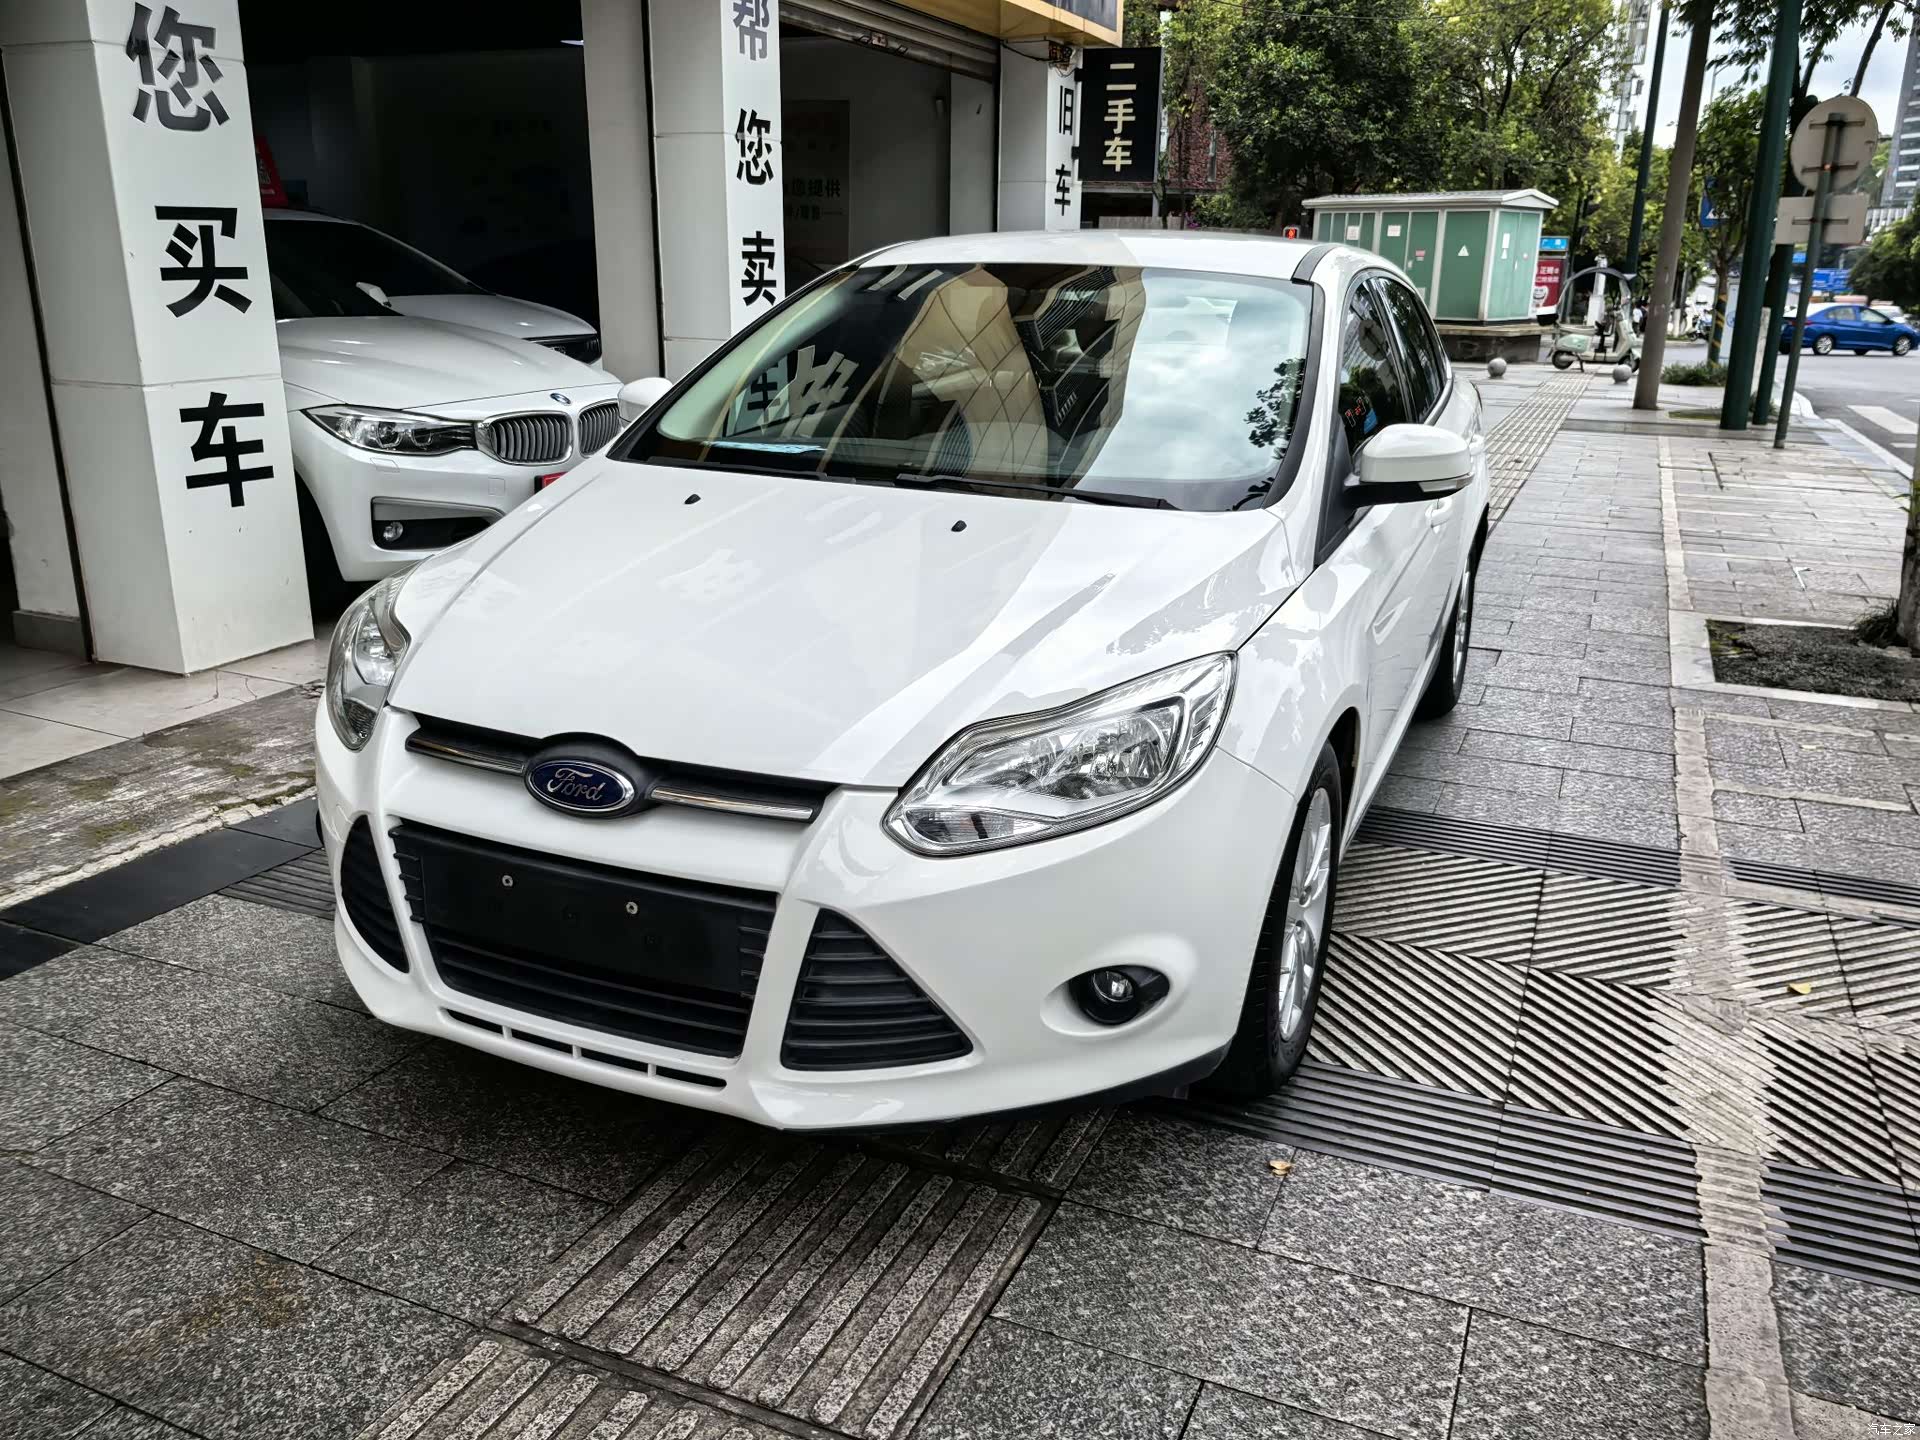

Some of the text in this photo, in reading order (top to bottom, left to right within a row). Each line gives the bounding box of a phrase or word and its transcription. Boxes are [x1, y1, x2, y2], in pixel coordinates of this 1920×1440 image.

[1054, 85, 1074, 216] 旧车
[1102, 62, 1137, 172] 二手车
[784, 177, 842, 199] 您提供
[126, 2, 274, 508] 您买车
[547, 768, 606, 800] Ford
